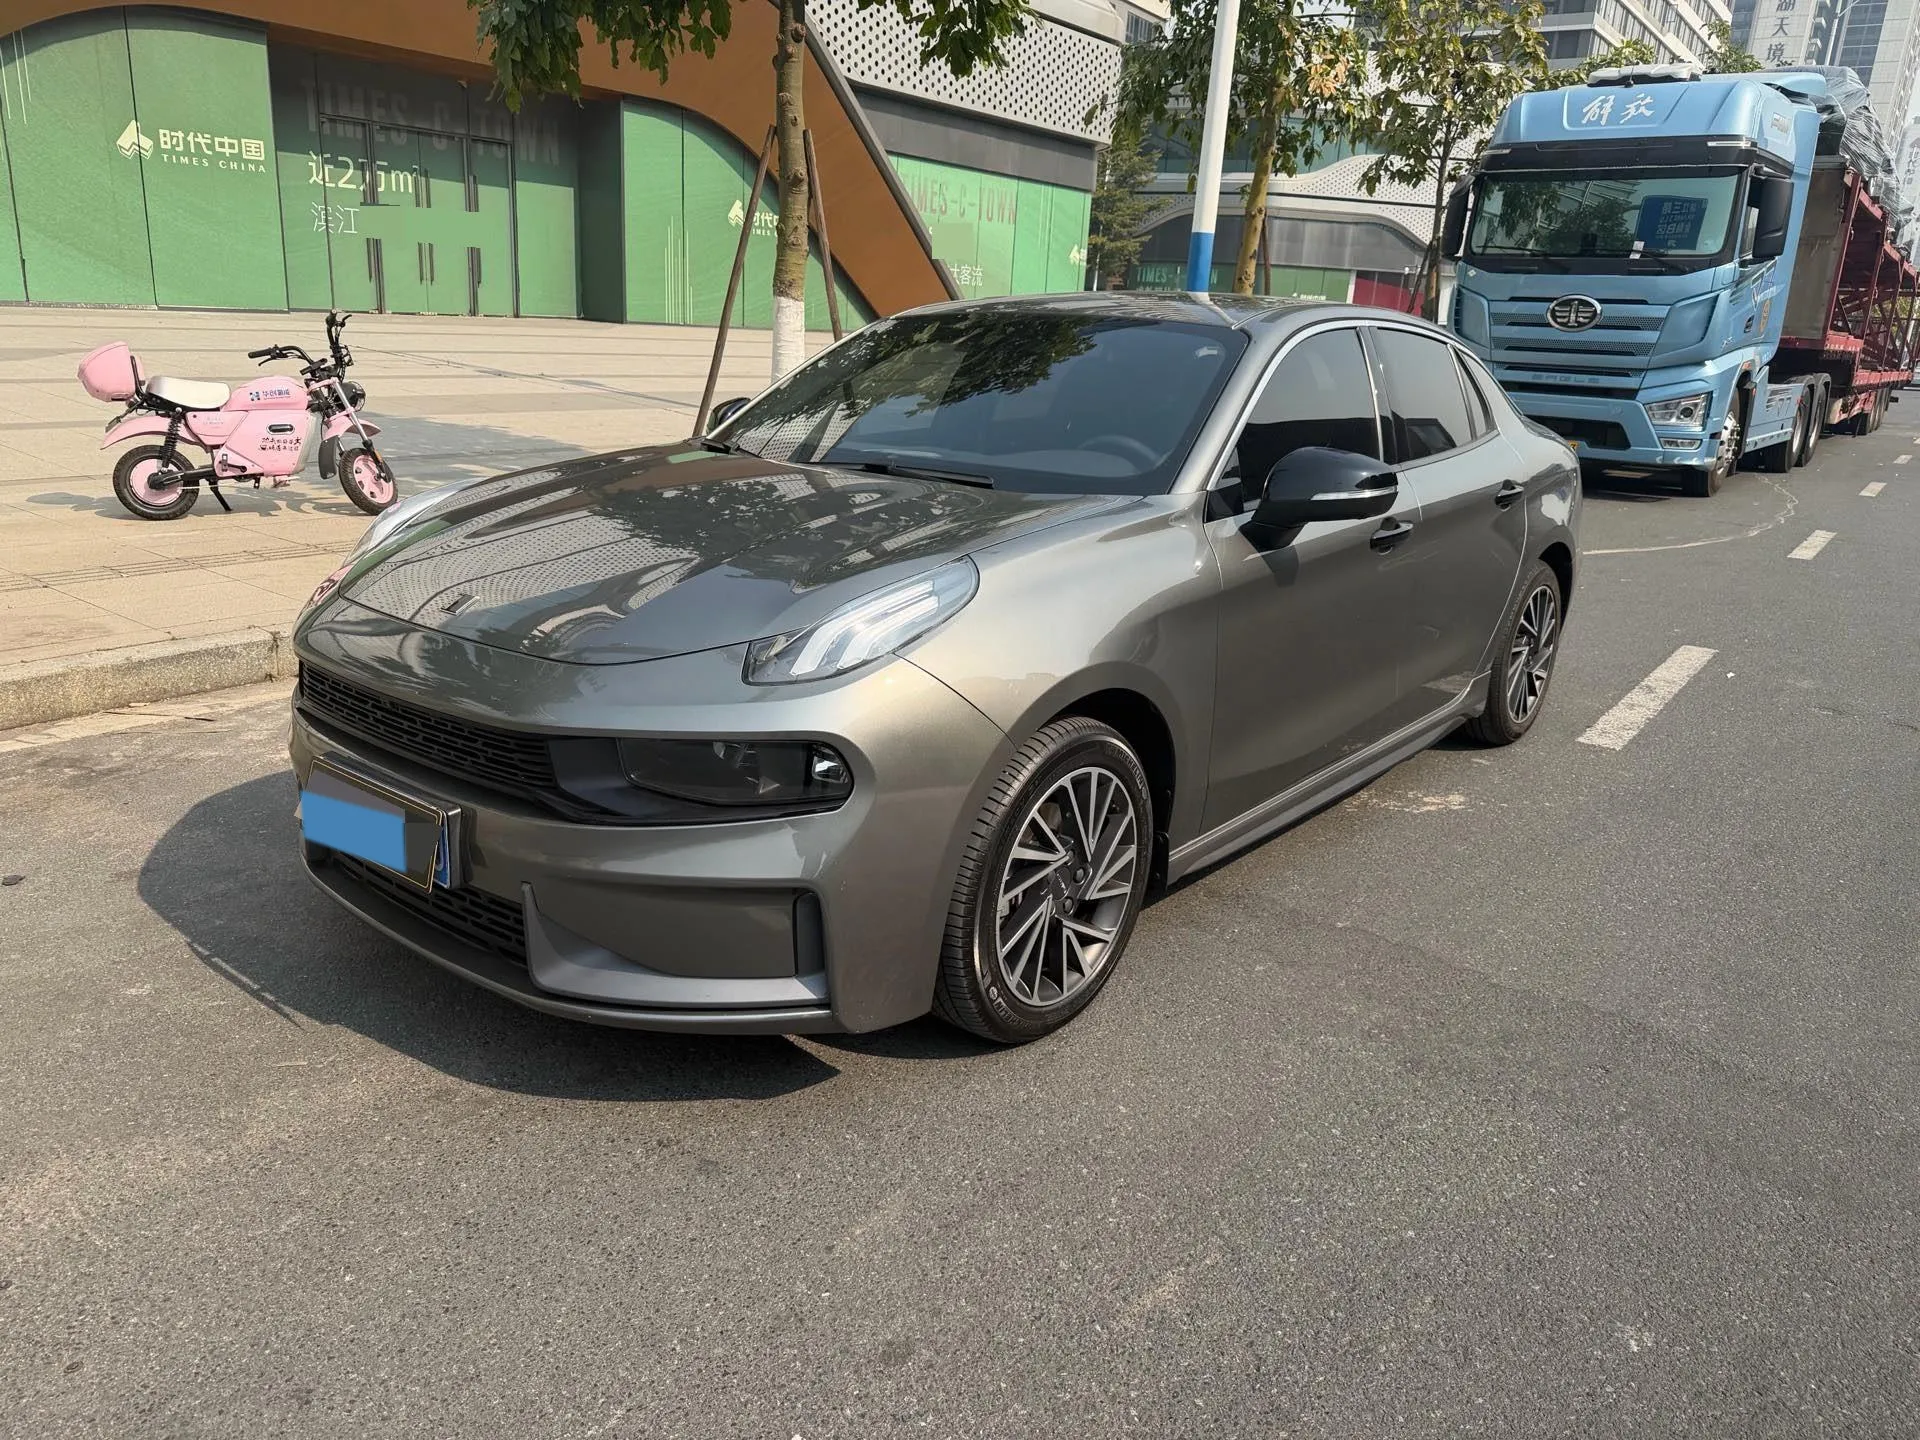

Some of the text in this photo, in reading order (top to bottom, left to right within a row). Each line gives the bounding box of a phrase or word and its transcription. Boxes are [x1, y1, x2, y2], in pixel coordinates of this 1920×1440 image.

[158, 128, 266, 161] 时代中国
[161, 153, 266, 173] TIMES CHINA
[311, 201, 360, 235] 滨江
